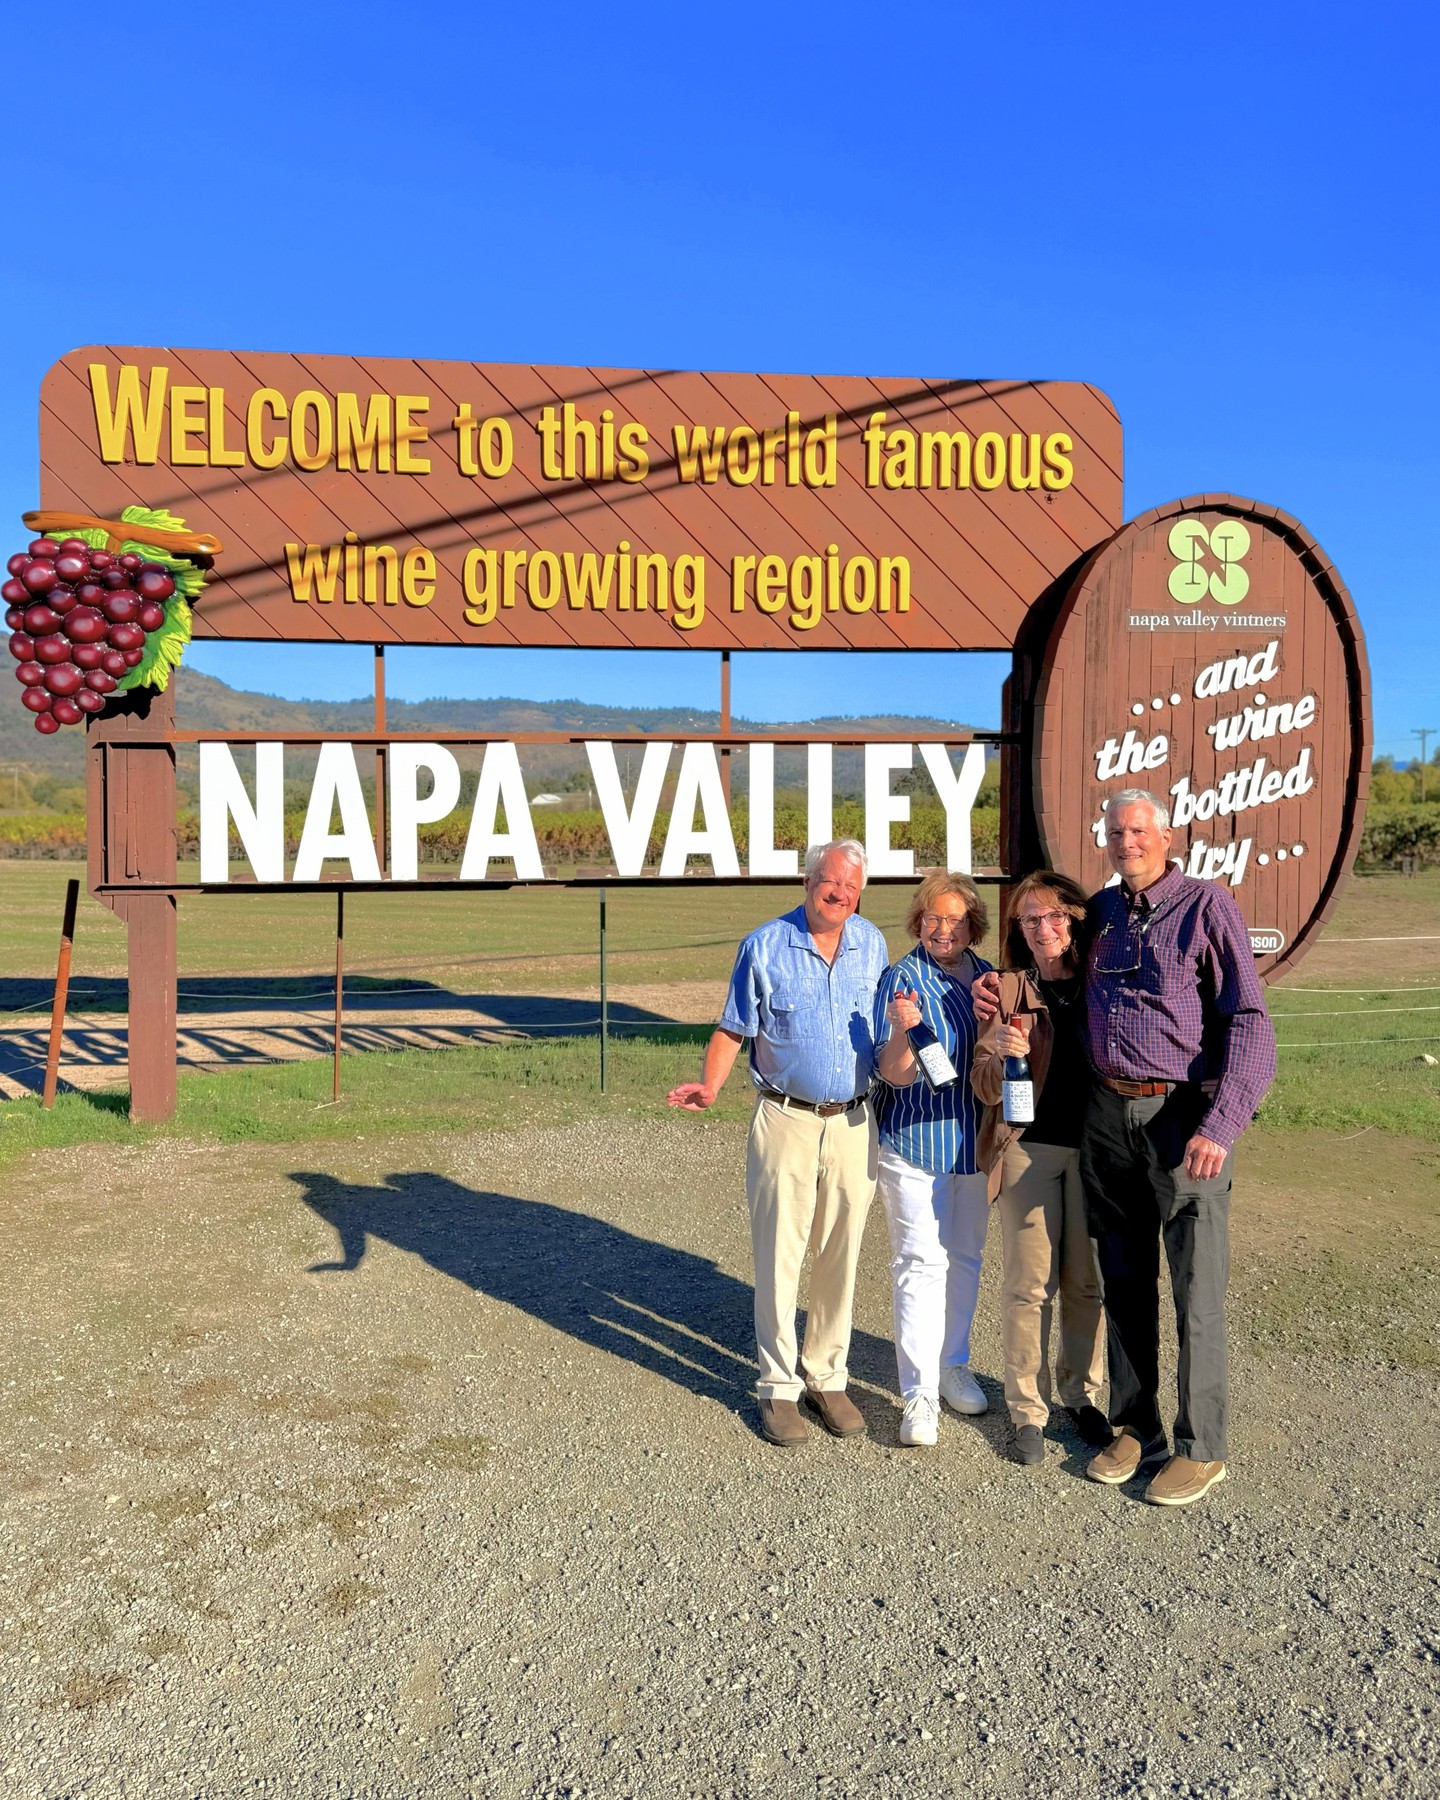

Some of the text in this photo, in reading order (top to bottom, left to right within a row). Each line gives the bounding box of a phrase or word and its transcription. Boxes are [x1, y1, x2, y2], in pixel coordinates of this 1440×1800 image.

[89, 363, 1074, 491] WELCOME to this world famous
[284, 531, 911, 630] wine growing region
[1129, 609, 1286, 631] napa valley vintners
[1096, 693, 1315, 781] the wine
[200, 741, 986, 883] NAPA VALLEY
[1170, 747, 1313, 828] bottled
